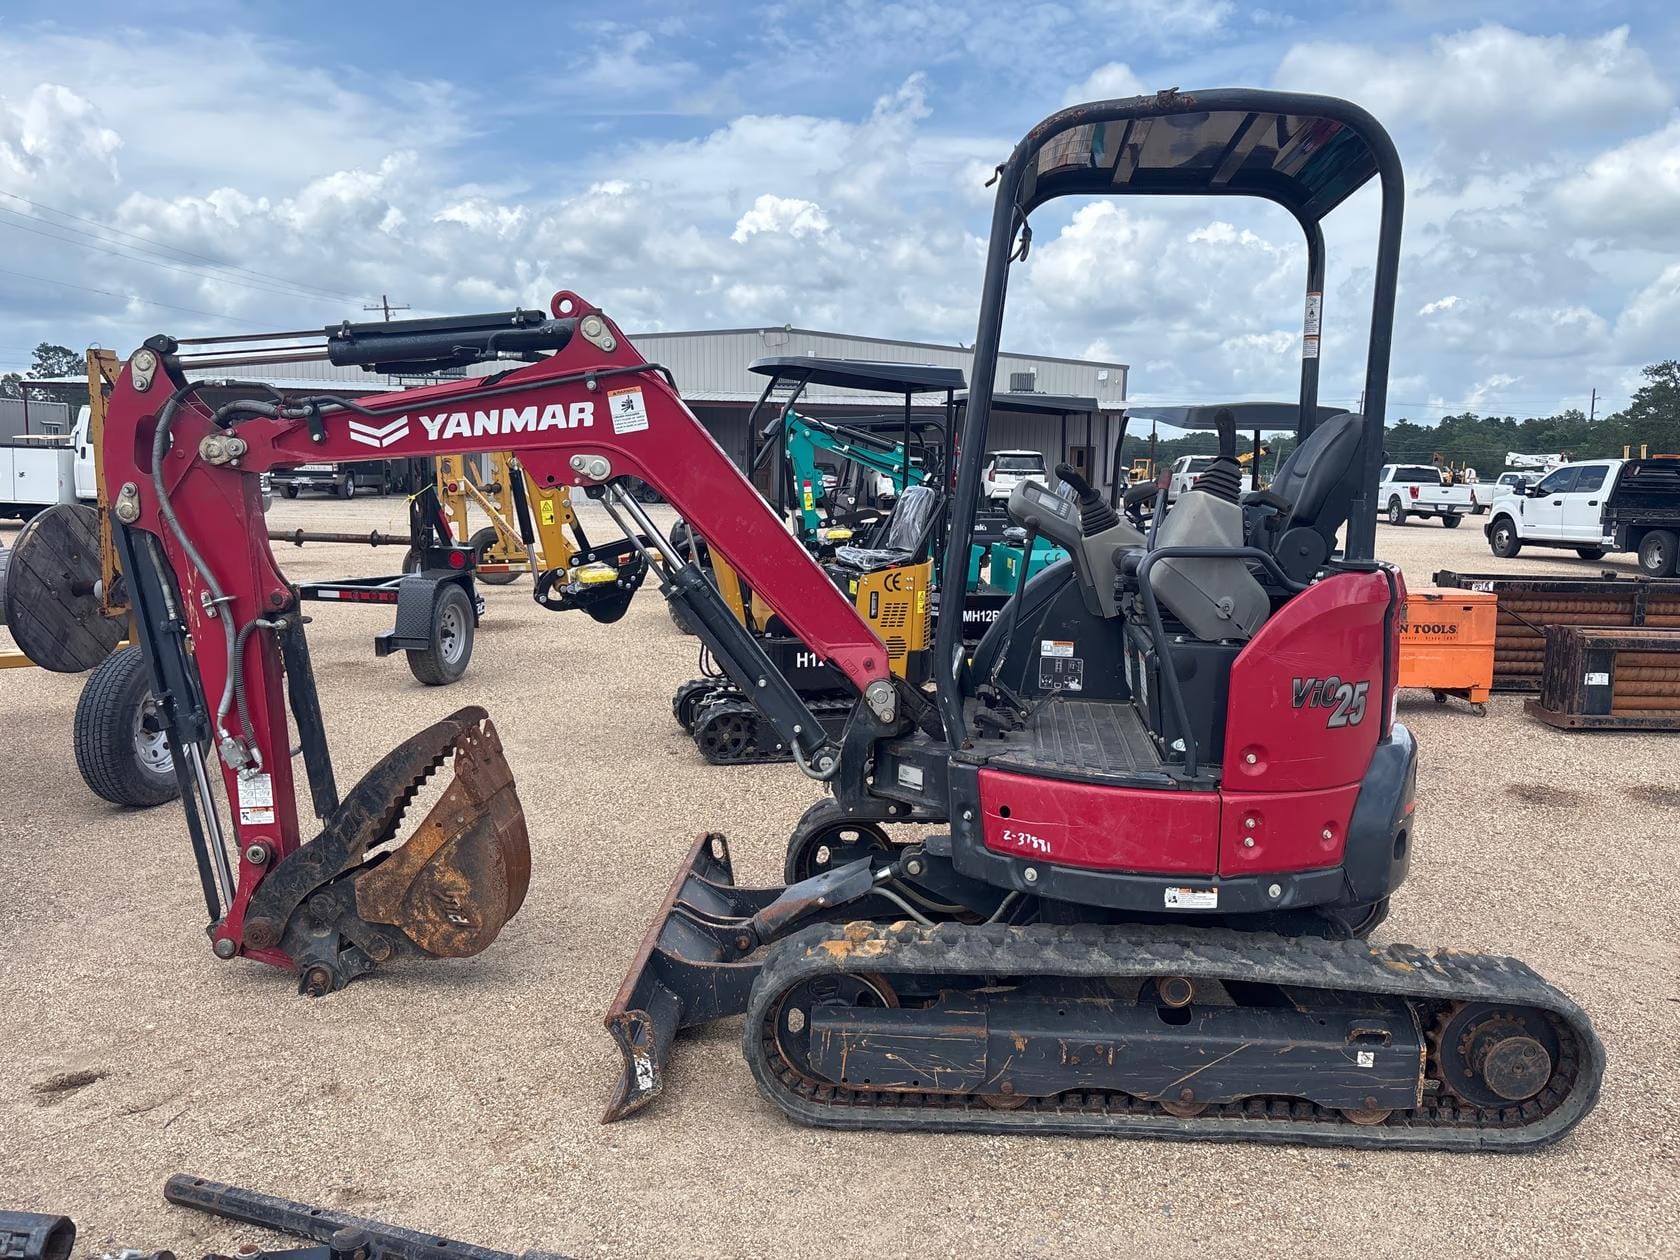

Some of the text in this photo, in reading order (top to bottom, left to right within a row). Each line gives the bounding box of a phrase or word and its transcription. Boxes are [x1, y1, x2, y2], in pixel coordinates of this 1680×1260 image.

[419, 402, 594, 440] YANMAR
[884, 573, 902, 592] CE
[1413, 624, 1457, 634] TOOLS
